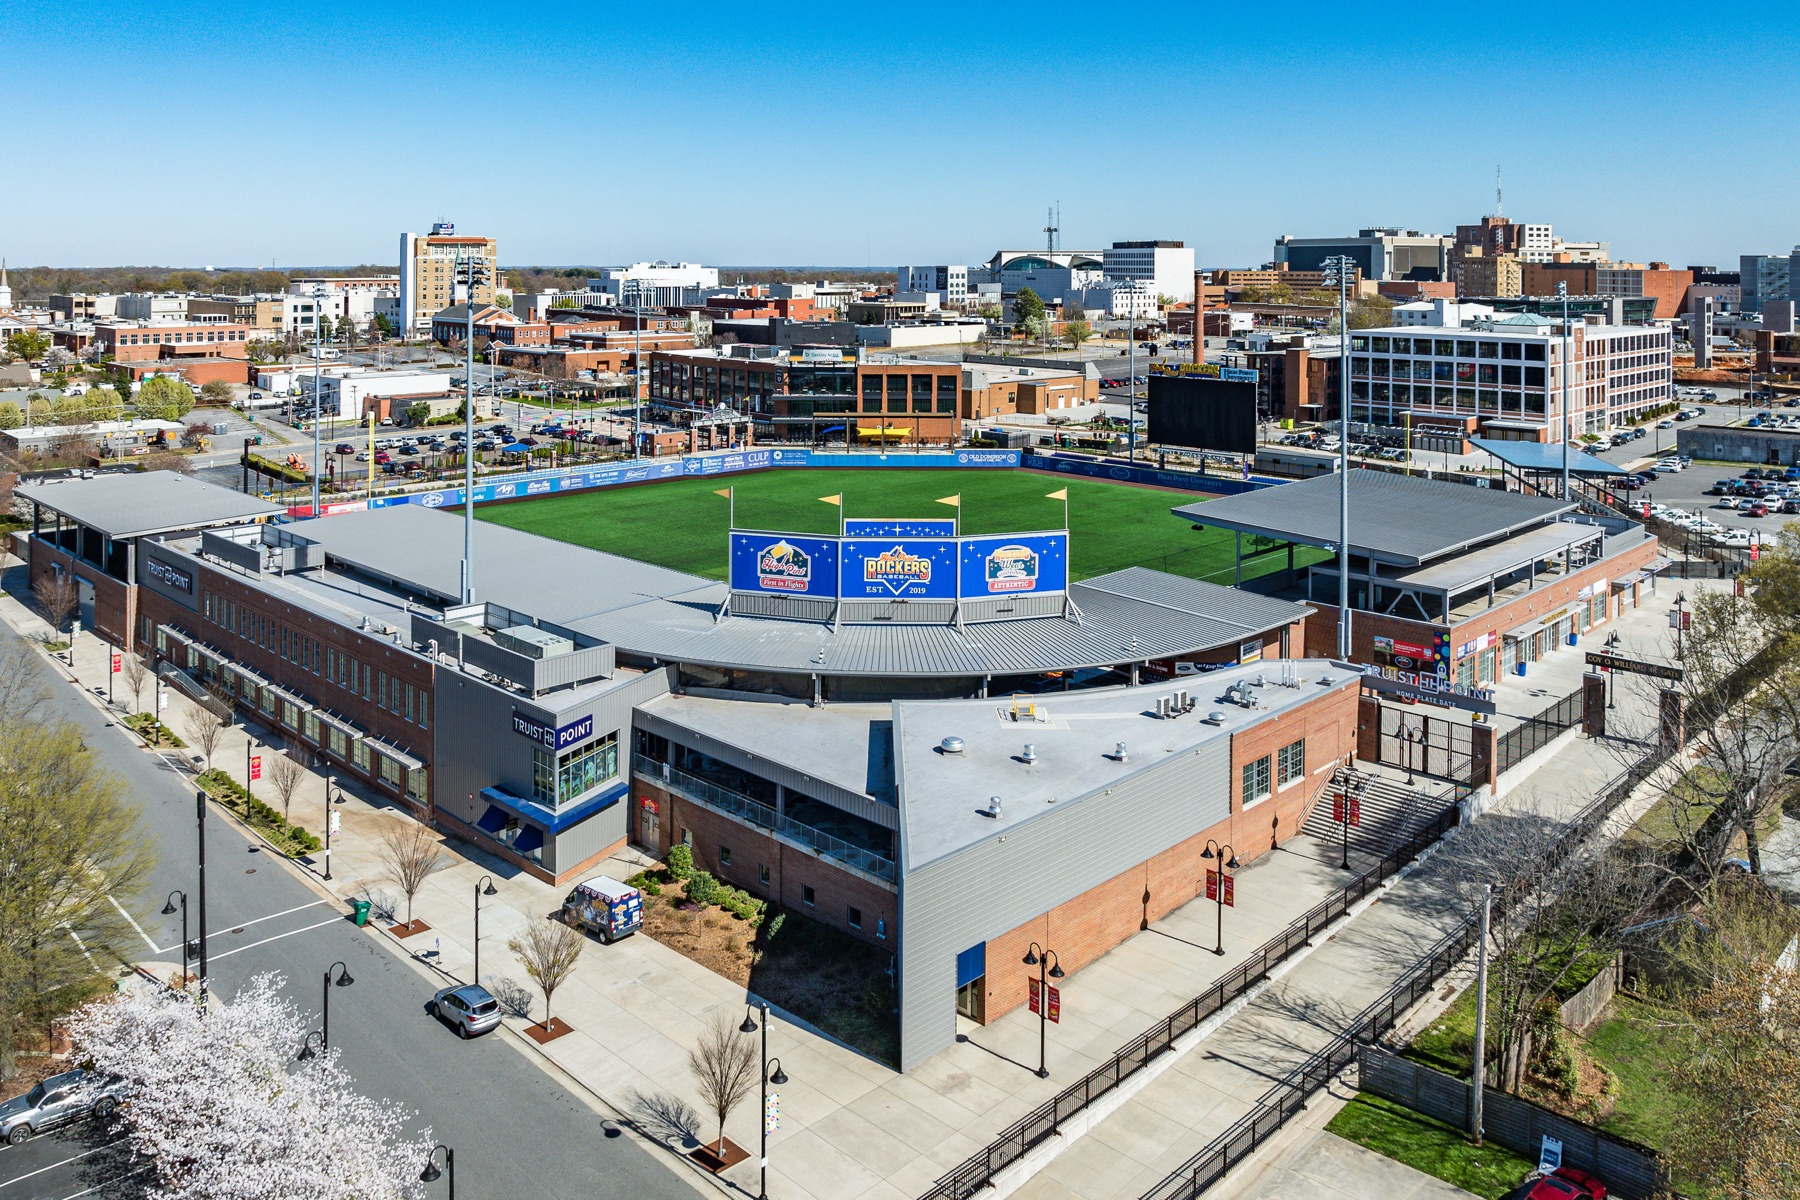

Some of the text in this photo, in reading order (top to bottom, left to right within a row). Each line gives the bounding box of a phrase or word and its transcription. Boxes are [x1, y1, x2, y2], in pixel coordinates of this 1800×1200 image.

[1179, 364, 1219, 379] ROCKERS
[748, 452, 769, 463] CULP
[1028, 459, 1044, 468] K&B
[762, 554, 789, 572] High
[784, 563, 807, 576] Pint
[867, 560, 930, 580] ROCKERS
[147, 561, 189, 589] TRUIST POINT
[784, 580, 804, 589] Flights
[1588, 655, 1602, 663] COY
[1361, 663, 1495, 702] TRUIST POINT
[1396, 690, 1457, 708] HOME PLATE GATE
[513, 717, 592, 745] TRUIST POINT
